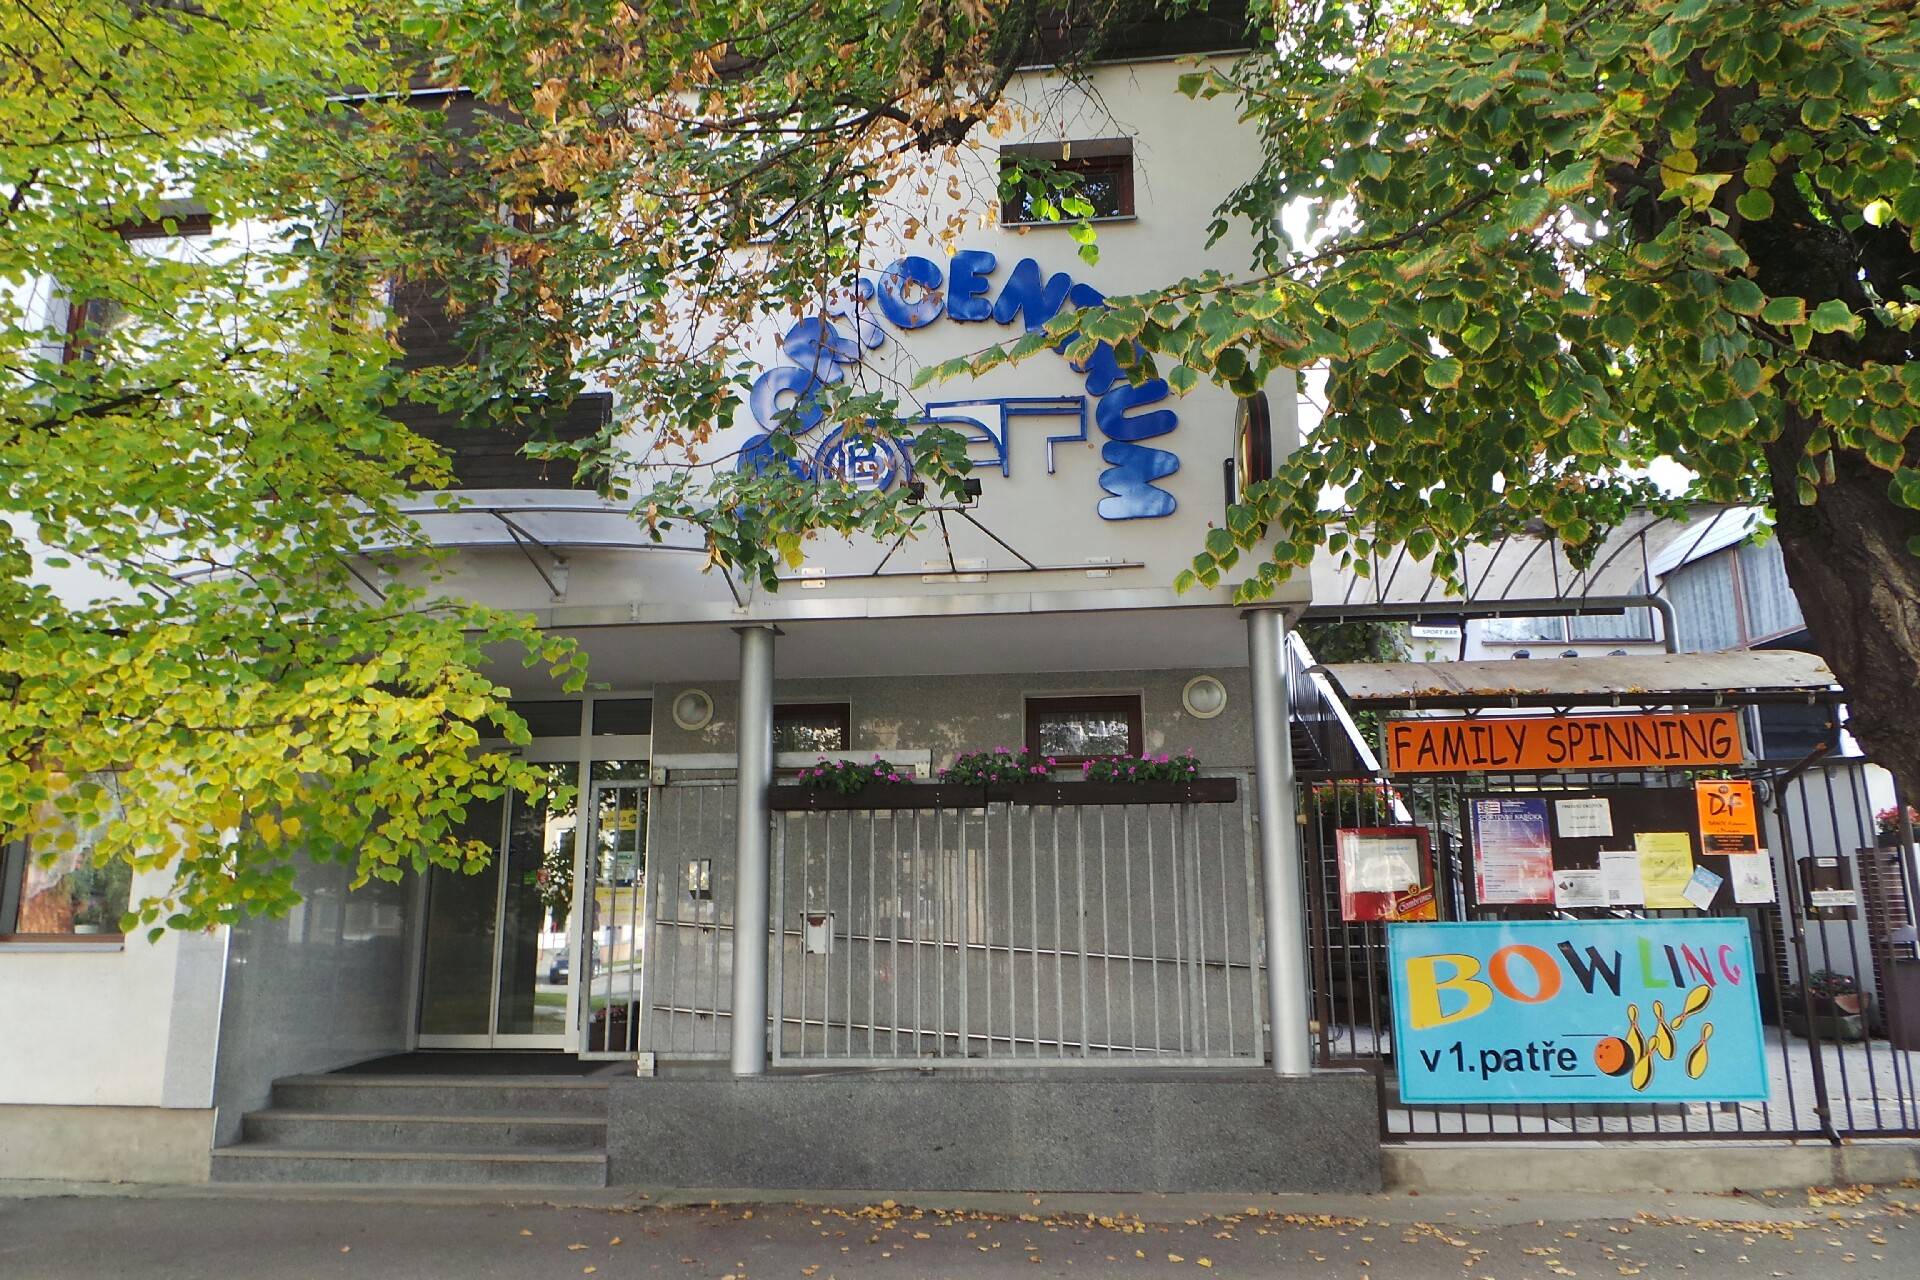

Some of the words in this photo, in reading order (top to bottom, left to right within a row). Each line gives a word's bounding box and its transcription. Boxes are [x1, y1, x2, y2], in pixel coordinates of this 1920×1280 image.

[1394, 724, 1527, 769] FAMILY
[1545, 717, 1733, 764] SPINNING
[1514, 812, 1544, 821] NABÍDKA
[1406, 936, 1742, 1031] BOWLING
[1420, 1050, 1441, 1073] v
[1449, 1040, 1578, 1082] 1.patře
